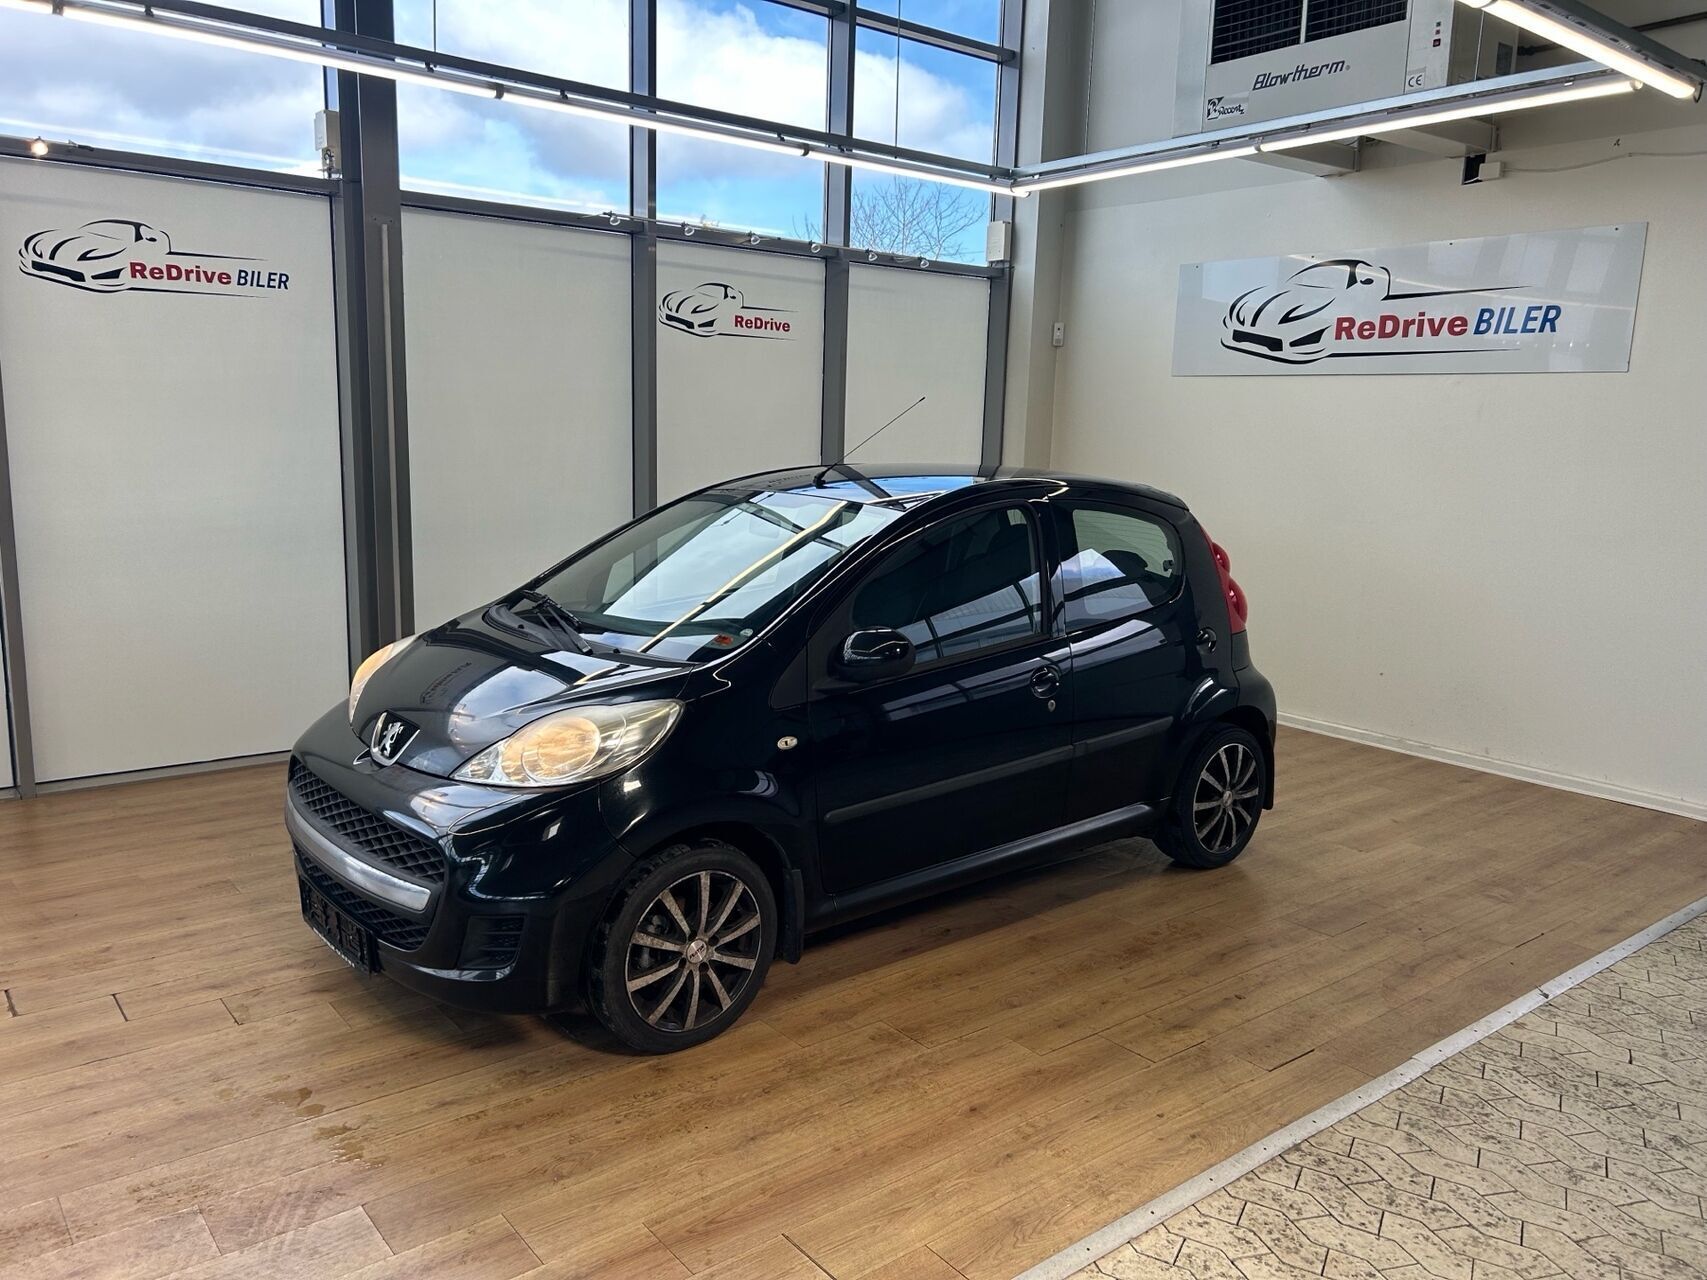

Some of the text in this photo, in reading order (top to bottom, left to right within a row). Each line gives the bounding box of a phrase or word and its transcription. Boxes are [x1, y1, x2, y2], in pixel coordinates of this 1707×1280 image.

[1252, 60, 1345, 91] Blowtherm
[1408, 74, 1422, 88] CE
[129, 261, 290, 290] ReDrive BILER
[734, 314, 791, 333] ReDrive
[1334, 305, 1562, 341] ReDrive BILER
